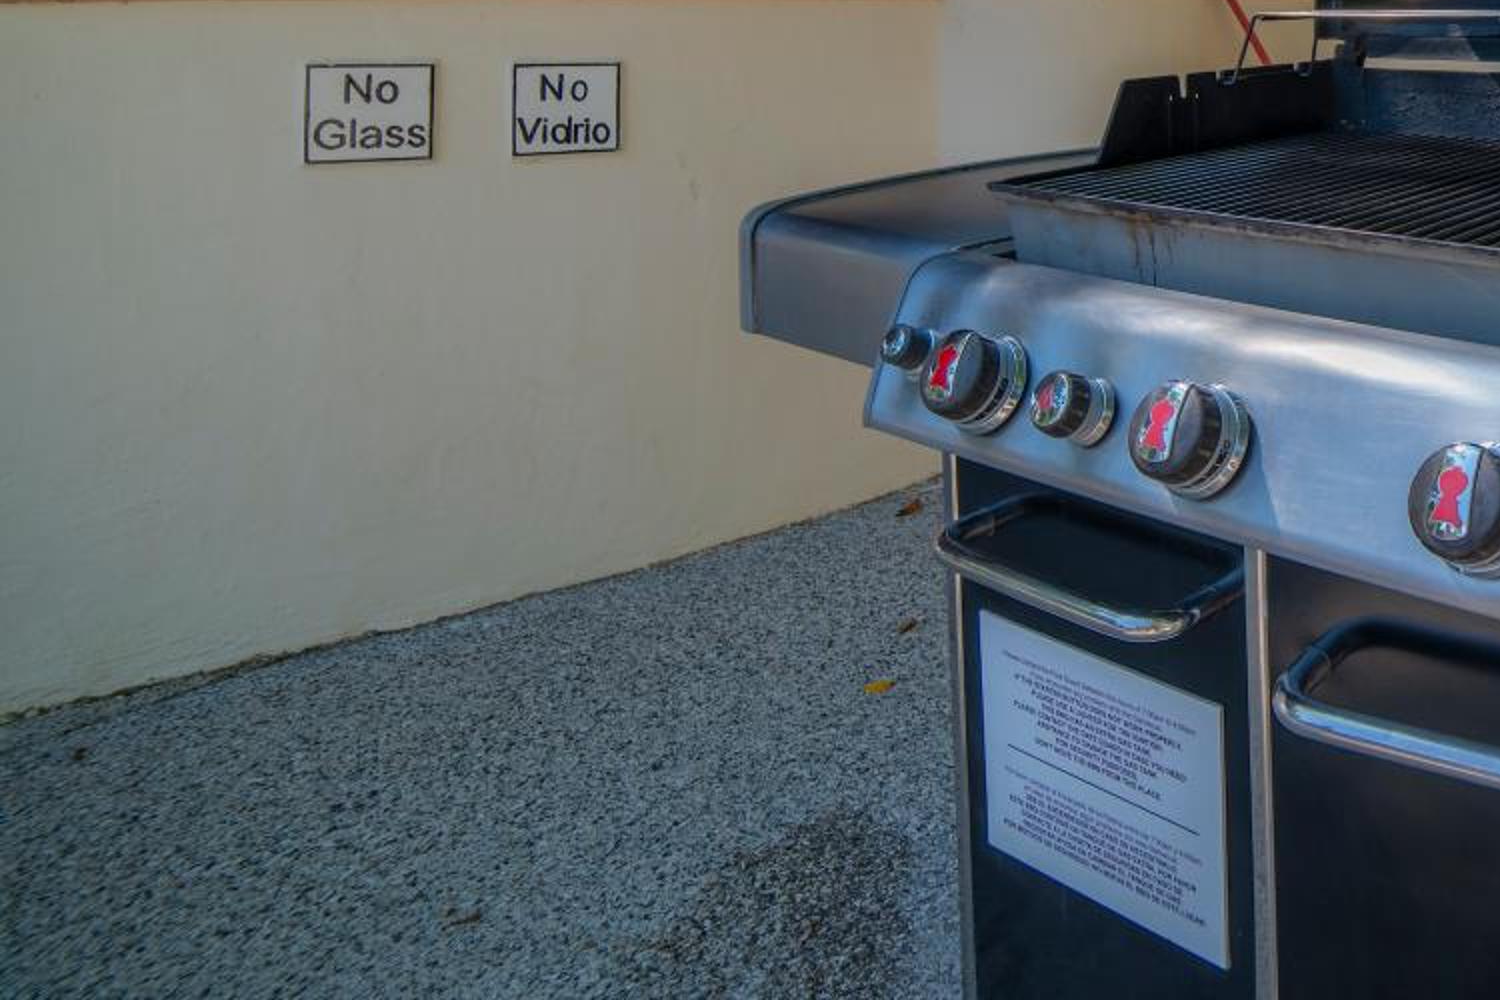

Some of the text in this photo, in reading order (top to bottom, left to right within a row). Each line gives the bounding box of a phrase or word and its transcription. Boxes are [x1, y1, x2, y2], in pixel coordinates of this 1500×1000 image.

[343, 73, 399, 104] No
[539, 73, 589, 102] No
[313, 118, 427, 150] Glass
[517, 116, 611, 145] Vidrio
